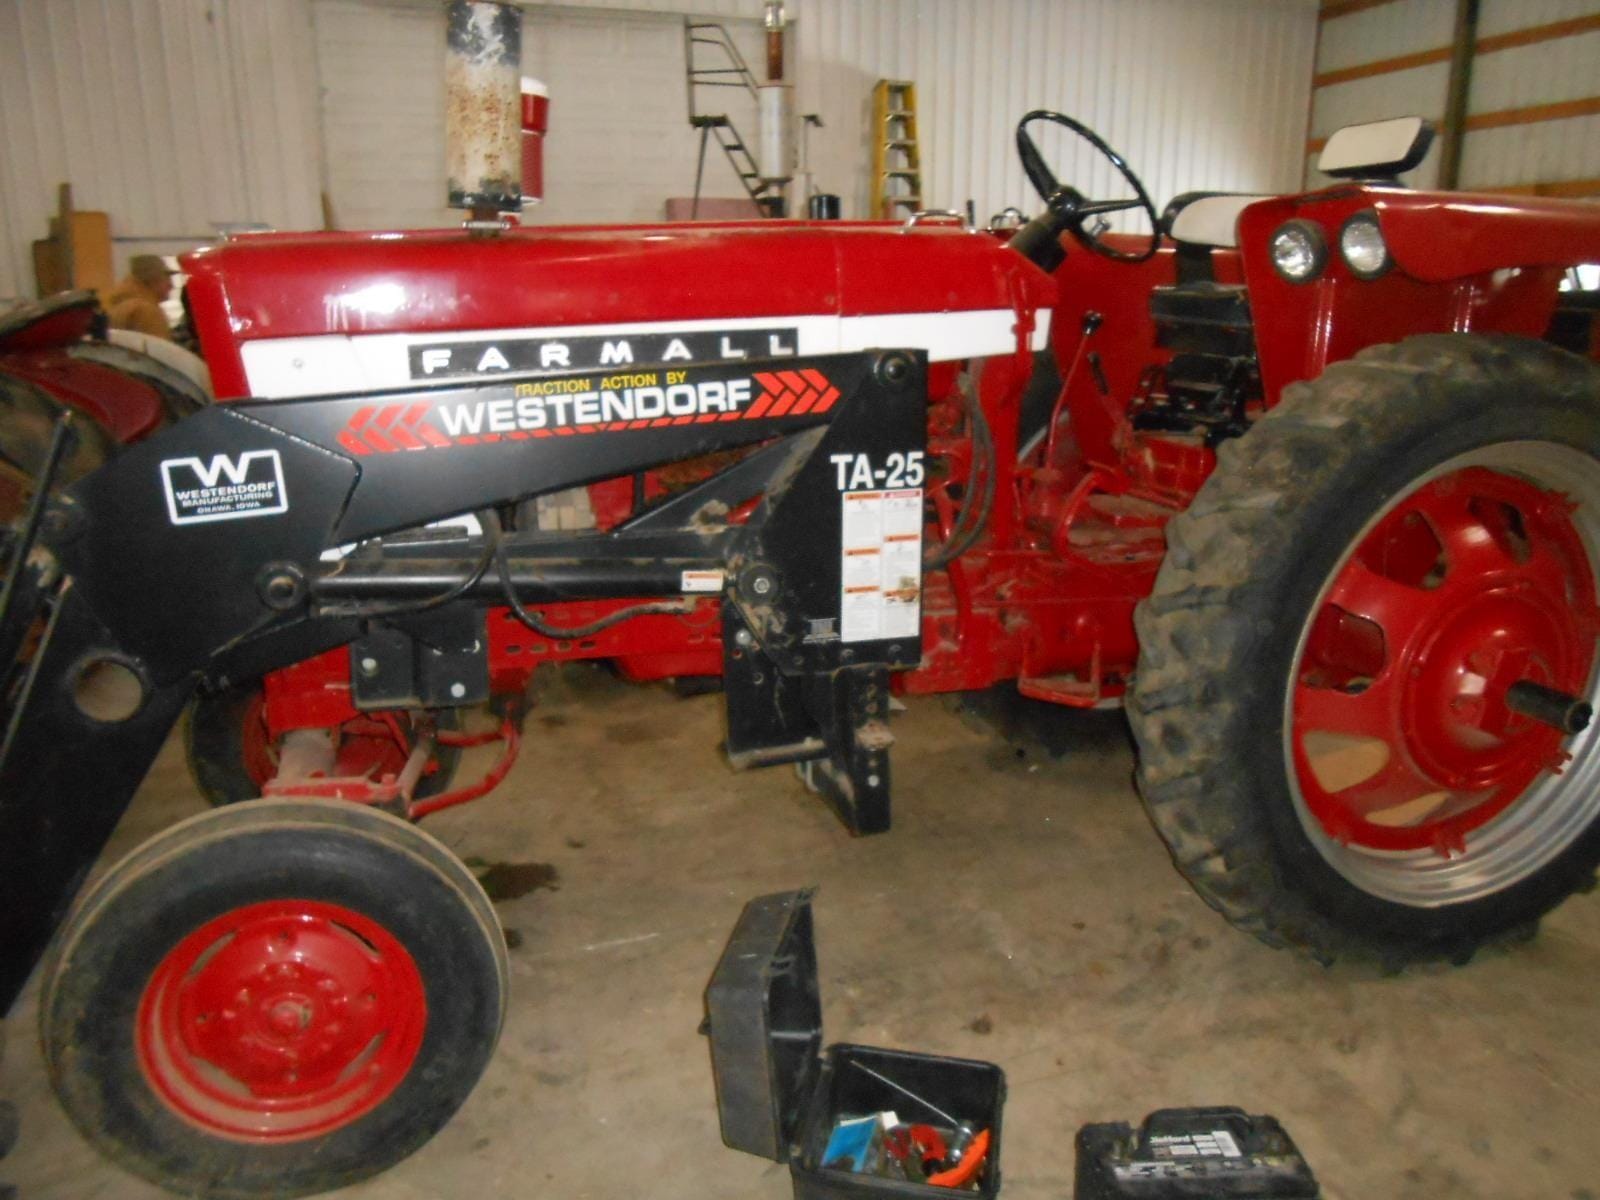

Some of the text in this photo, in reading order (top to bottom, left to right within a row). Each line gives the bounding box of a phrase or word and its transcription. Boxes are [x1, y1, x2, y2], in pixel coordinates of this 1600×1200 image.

[422, 334, 793, 374] FARMALL
[514, 371, 687, 397] TRACTION ACTION BY
[438, 379, 751, 436] WESTENDORF
[830, 451, 925, 490] TA-25
[176, 481, 276, 501] WESTENDORF
[182, 491, 273, 508] MANUFACTURING
[236, 501, 261, 511] IOWA
